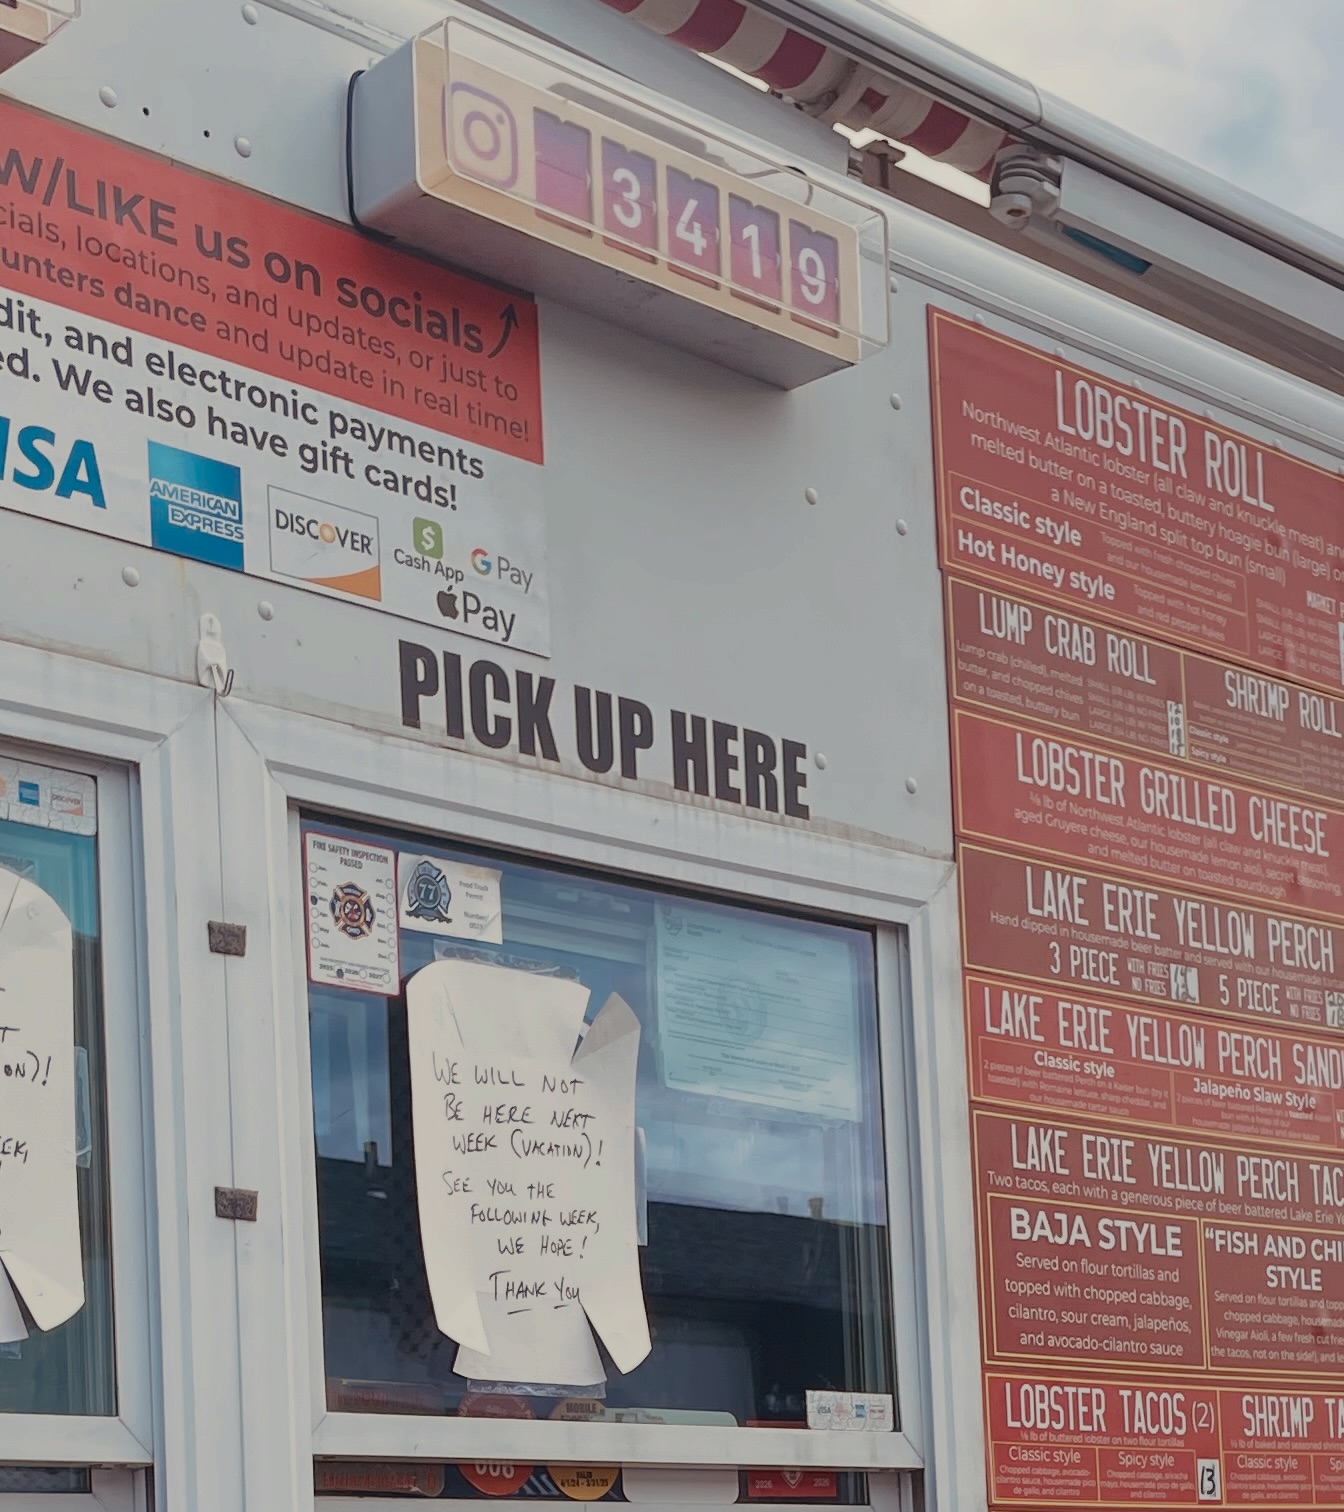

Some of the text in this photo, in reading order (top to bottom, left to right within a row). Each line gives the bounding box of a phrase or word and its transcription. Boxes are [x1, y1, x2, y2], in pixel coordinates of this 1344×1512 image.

[76, 224, 217, 304] locations,
[225, 284, 278, 320] and
[287, 305, 402, 367] updates,
[408, 349, 435, 373] or
[442, 352, 488, 393] just
[493, 375, 518, 402] to
[194, 223, 251, 270] us
[263, 251, 322, 298] on
[335, 276, 485, 354] socials
[50, 357, 114, 405] We
[124, 385, 197, 429] also
[207, 405, 289, 458] have
[297, 439, 356, 480] gift
[363, 464, 457, 512] cards!
[64, 325, 134, 368] and
[145, 349, 320, 426] electronic
[328, 409, 485, 480] payments
[1054, 369, 1275, 513] LOBSTER ROLL
[957, 528, 1116, 601] Hot Honey style
[398, 639, 810, 821] PICK UP HERE
[1015, 732, 1330, 858] LOBSTER GRILLED CHEESE
[312, 839, 389, 865] FIRE SAFETY INSPECTION
[418, 881, 439, 901] 77
[1025, 865, 1335, 974] LAKE ERIE YELLOW PERCH
[1048, 940, 1121, 986] 3 PIECE
[1010, 1206, 1183, 1258] BAJA STYLE
[1015, 1251, 1180, 1284] Served on flour tortillas and
[1265, 1264, 1323, 1292] STYLE
[1005, 1381, 1216, 1436] LOBSTER TACOS (2)
[1199, 1463, 1216, 1497] 13
